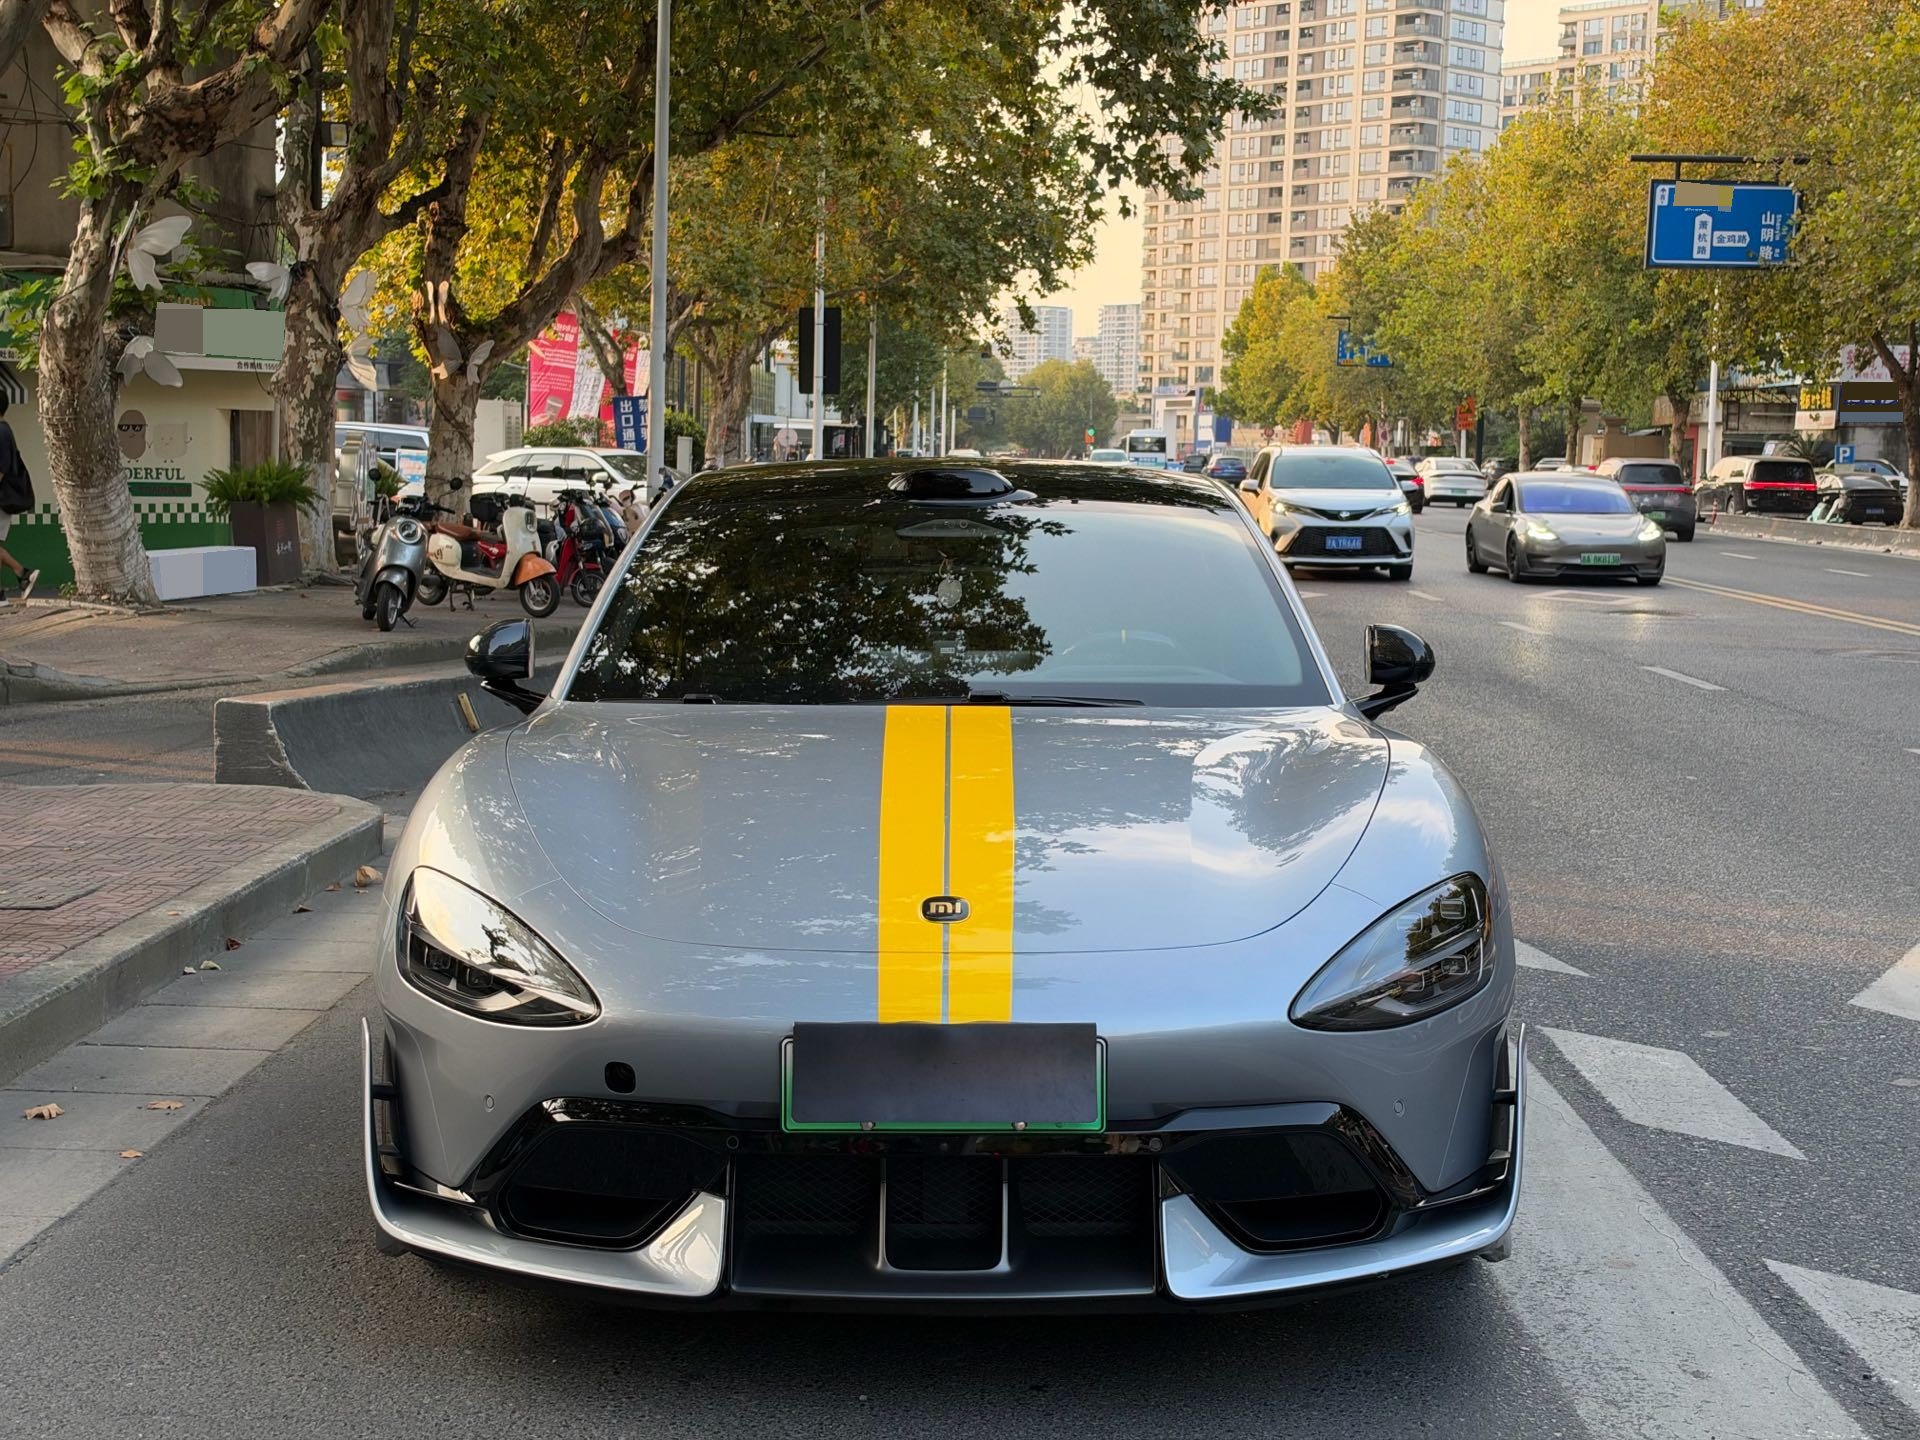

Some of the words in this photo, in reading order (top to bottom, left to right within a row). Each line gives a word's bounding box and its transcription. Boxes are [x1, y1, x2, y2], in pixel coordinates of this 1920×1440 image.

[1696, 220, 1708, 255] 萧杭路
[1716, 234, 1747, 245] 金鸡路
[1759, 211, 1776, 260] 山阴路
[1839, 449, 1850, 462] P
